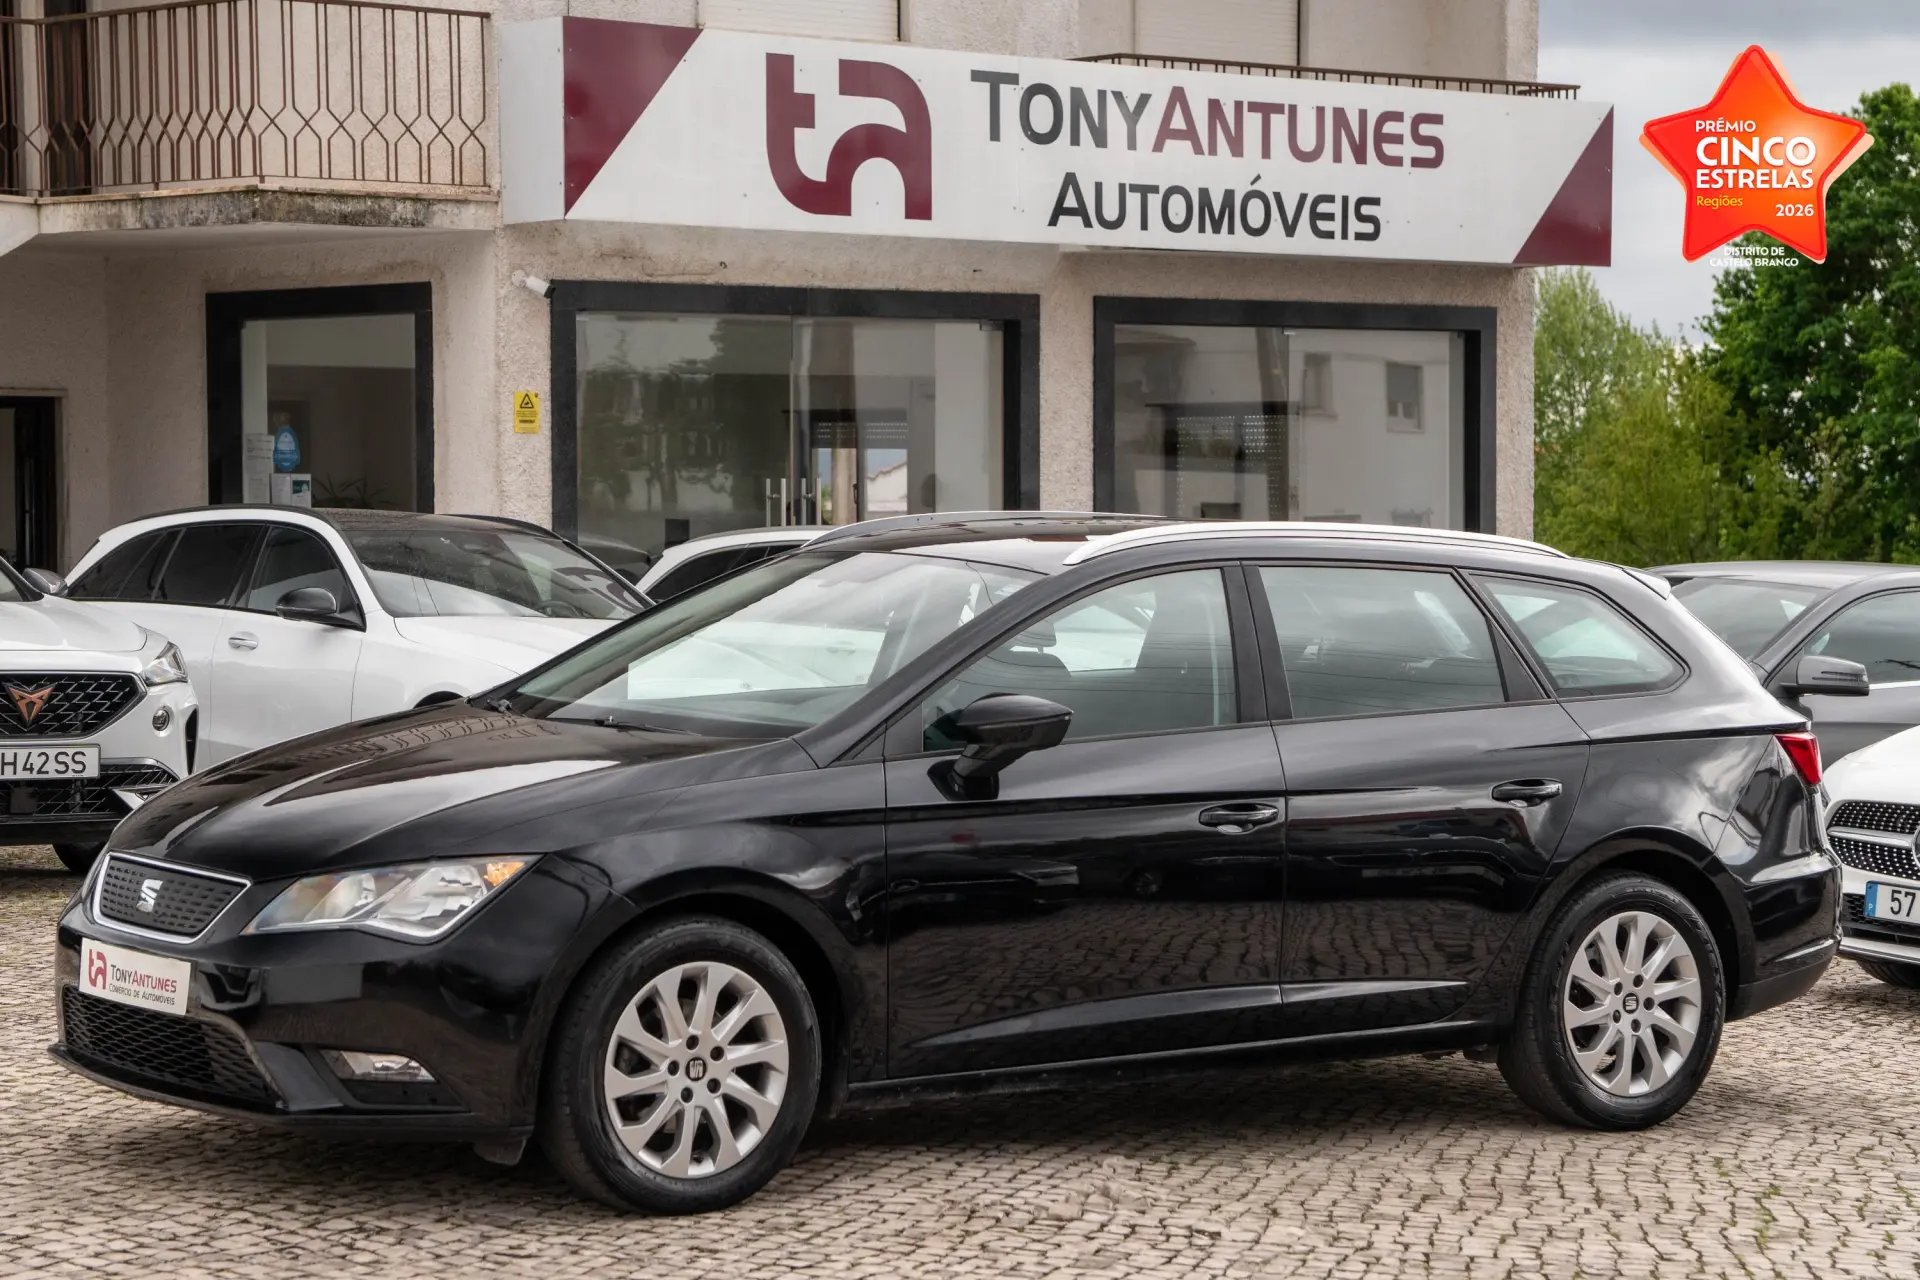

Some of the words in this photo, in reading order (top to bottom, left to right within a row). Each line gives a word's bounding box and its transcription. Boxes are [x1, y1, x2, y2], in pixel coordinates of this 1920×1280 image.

[1048, 172, 1381, 241] AUTOMÓVEIS
[1890, 889, 1916, 917] 57
[133, 989, 140, 998] DE
